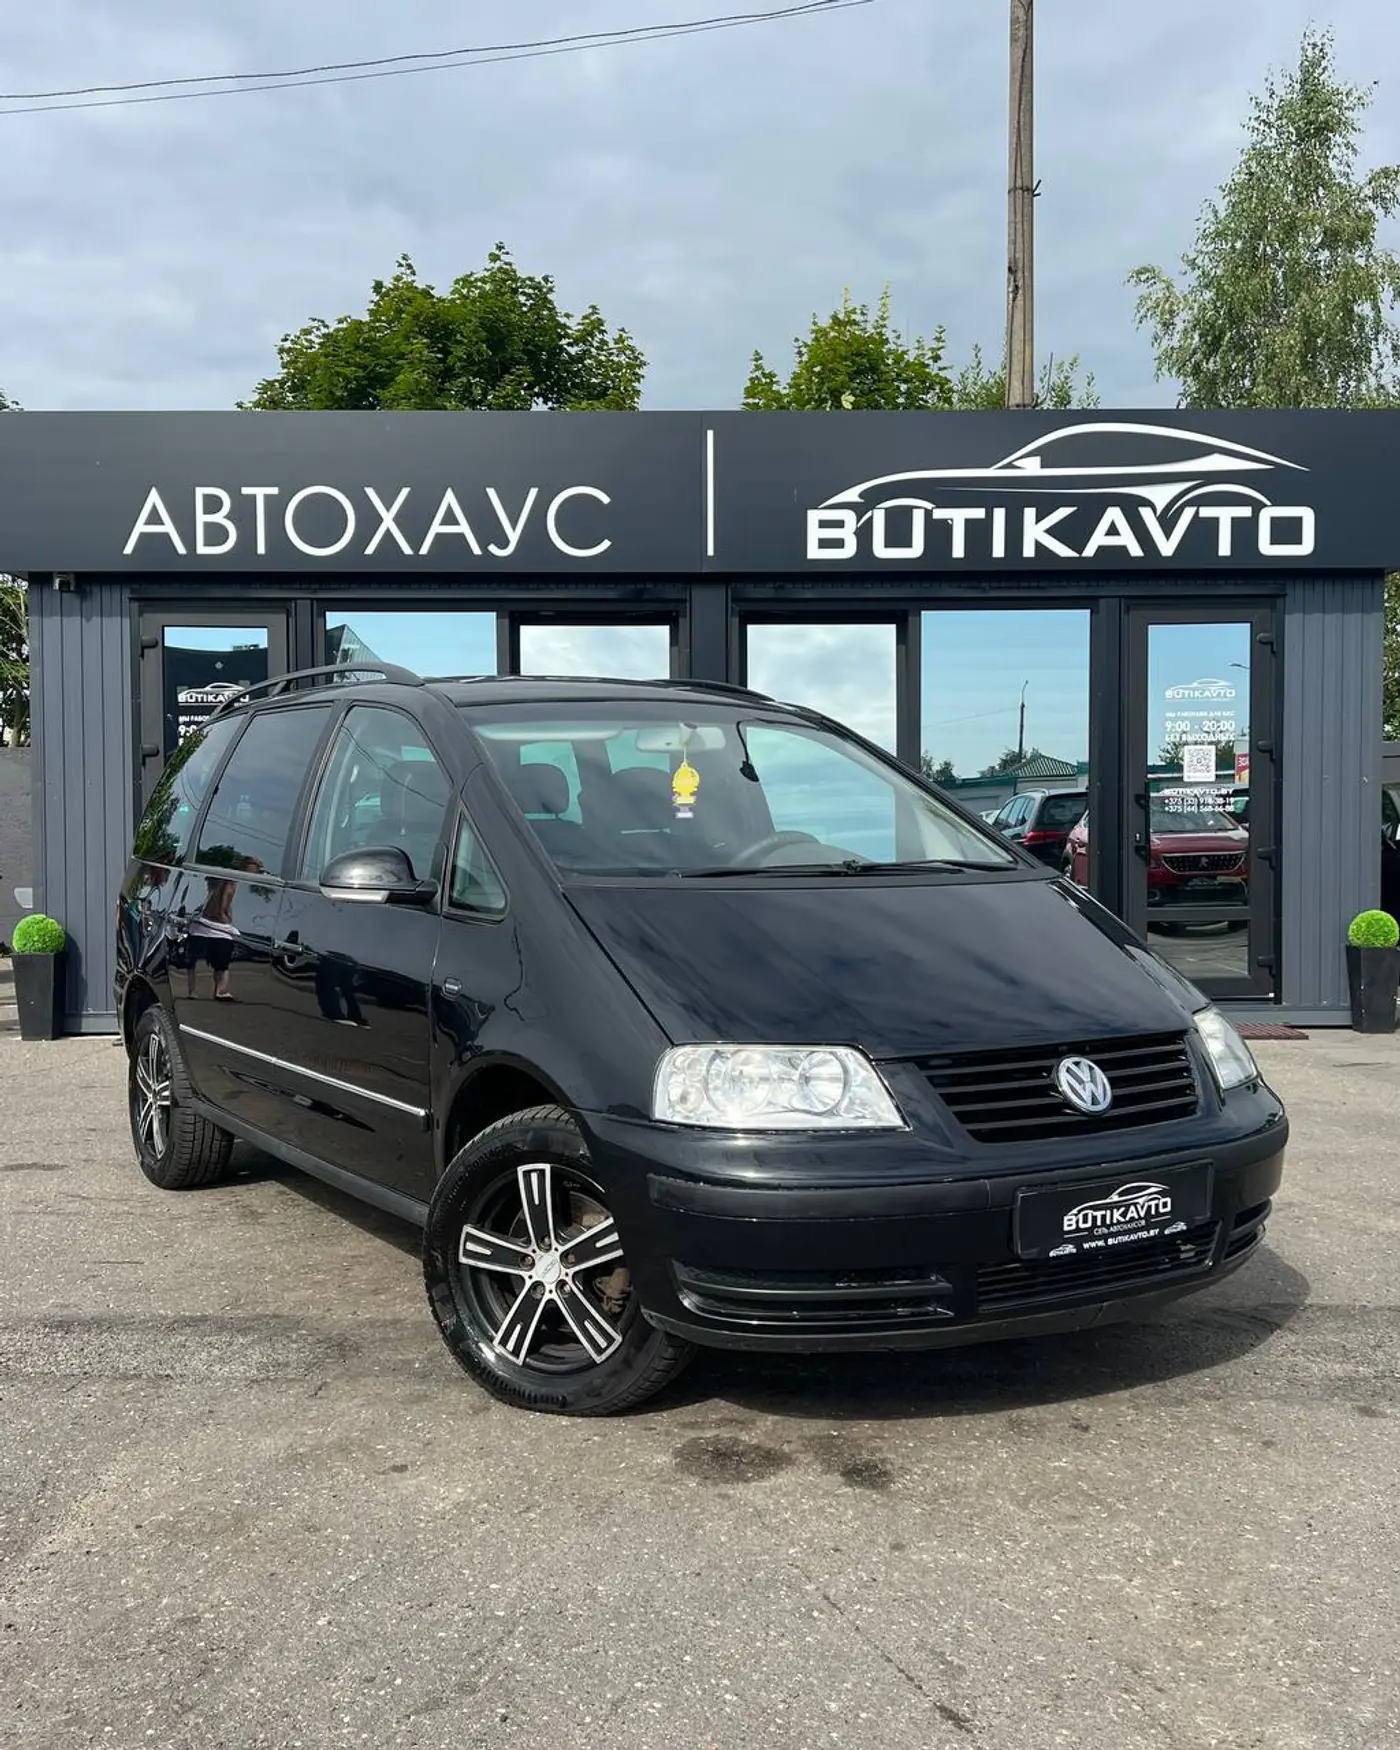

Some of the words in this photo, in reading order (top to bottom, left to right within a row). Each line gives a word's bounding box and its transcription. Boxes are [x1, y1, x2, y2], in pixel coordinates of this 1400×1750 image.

[122, 485, 612, 557] АВТОХАУС
[806, 505, 1316, 560] BUTIKAVTO
[1165, 689, 1236, 698] BUTIKAVTO
[1165, 721, 1191, 732] 9:00
[1202, 720, 1236, 732] 20:00
[1164, 797, 1182, 805] +375
[1164, 805, 1182, 813] +375
[1063, 1197, 1171, 1231] BUTIKAVTO
